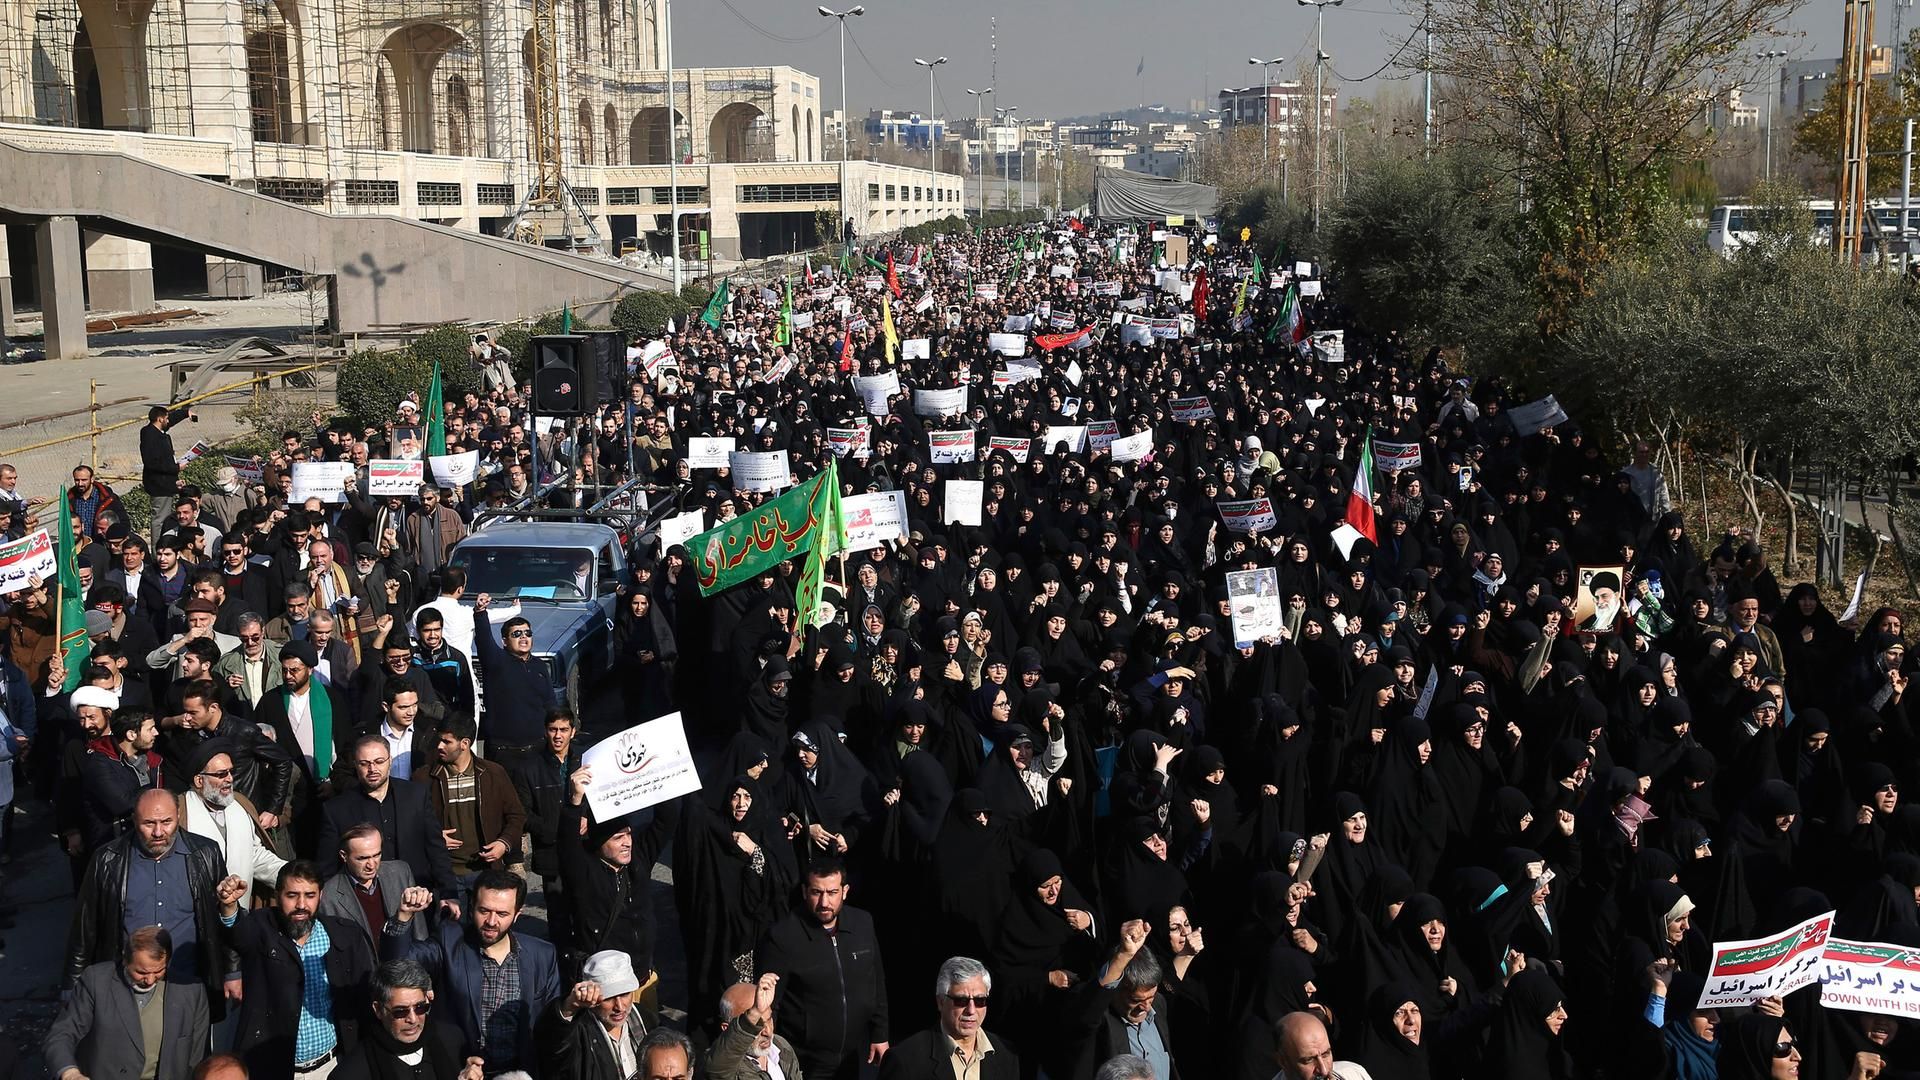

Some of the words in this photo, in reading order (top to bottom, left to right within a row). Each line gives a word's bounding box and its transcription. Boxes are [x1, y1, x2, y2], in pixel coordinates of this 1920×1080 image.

[1709, 975, 1773, 996] اسرائیل
[1816, 964, 1883, 990] اسرائیل
[1889, 978, 1905, 995] بر
[1704, 997, 1746, 1005] DOWN
[1865, 996, 1901, 1010] WITH
[1905, 1001, 1920, 1013] IS
